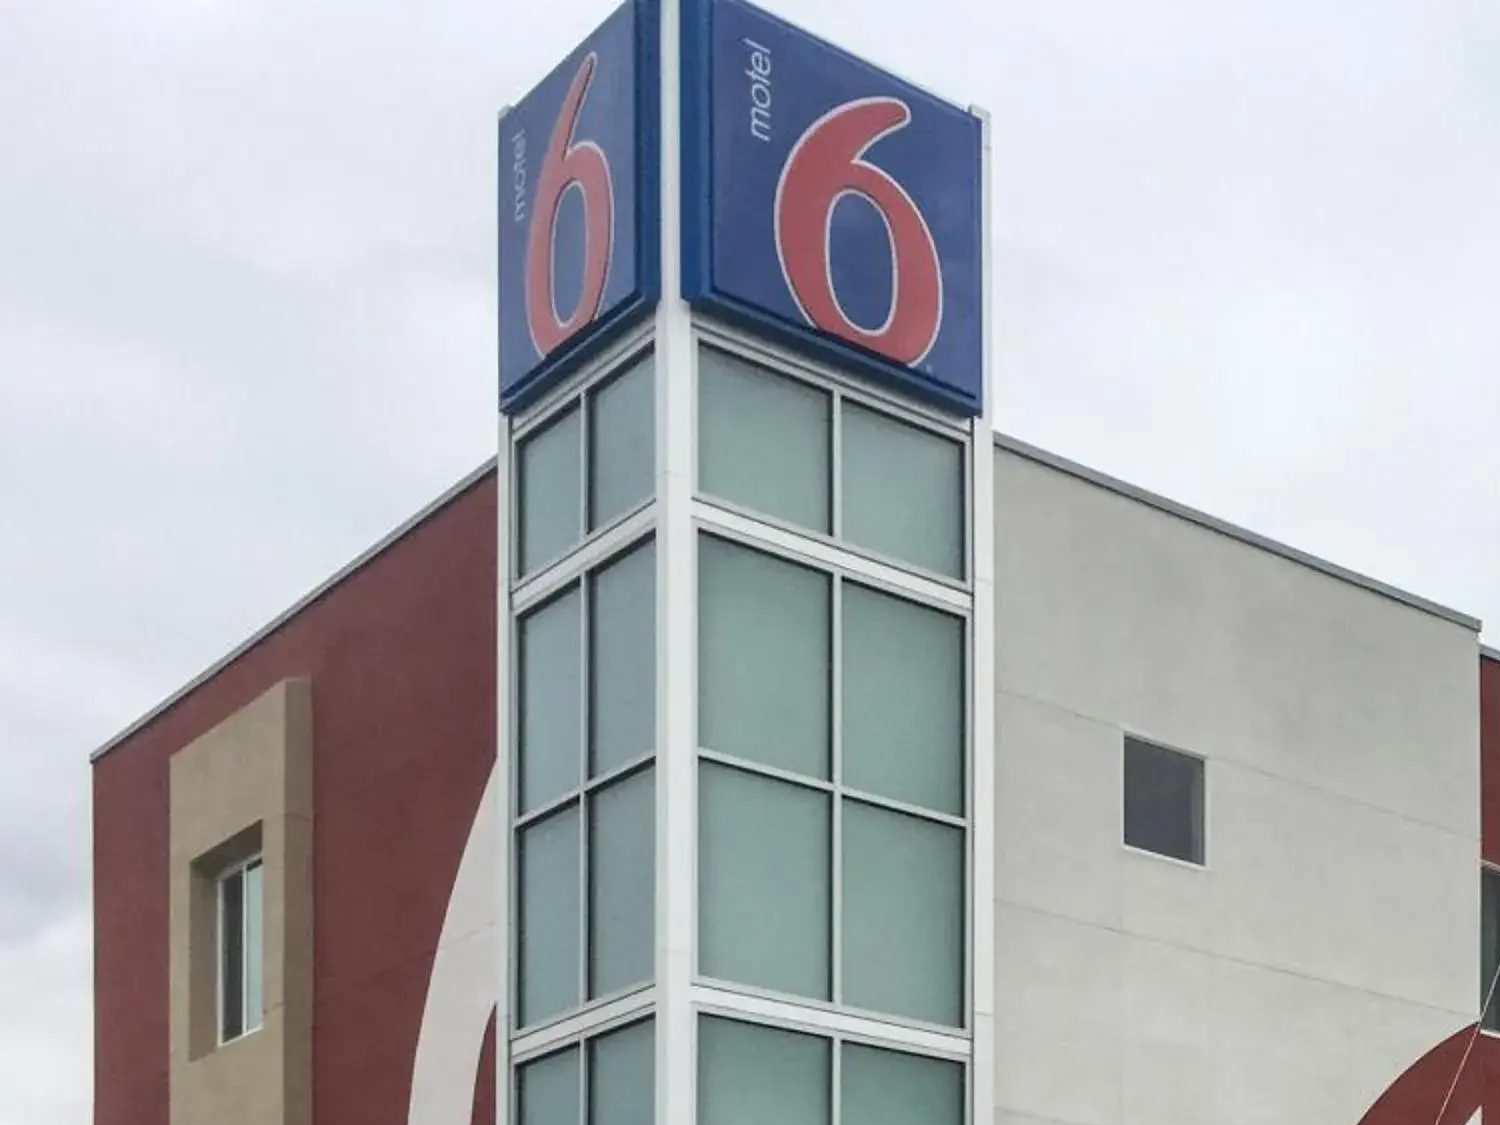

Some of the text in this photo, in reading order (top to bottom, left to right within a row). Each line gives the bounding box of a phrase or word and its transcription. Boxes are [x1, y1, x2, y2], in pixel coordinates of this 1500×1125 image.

[525, 50, 615, 361] 6
[743, 38, 771, 141] motel
[774, 96, 943, 368] 6
